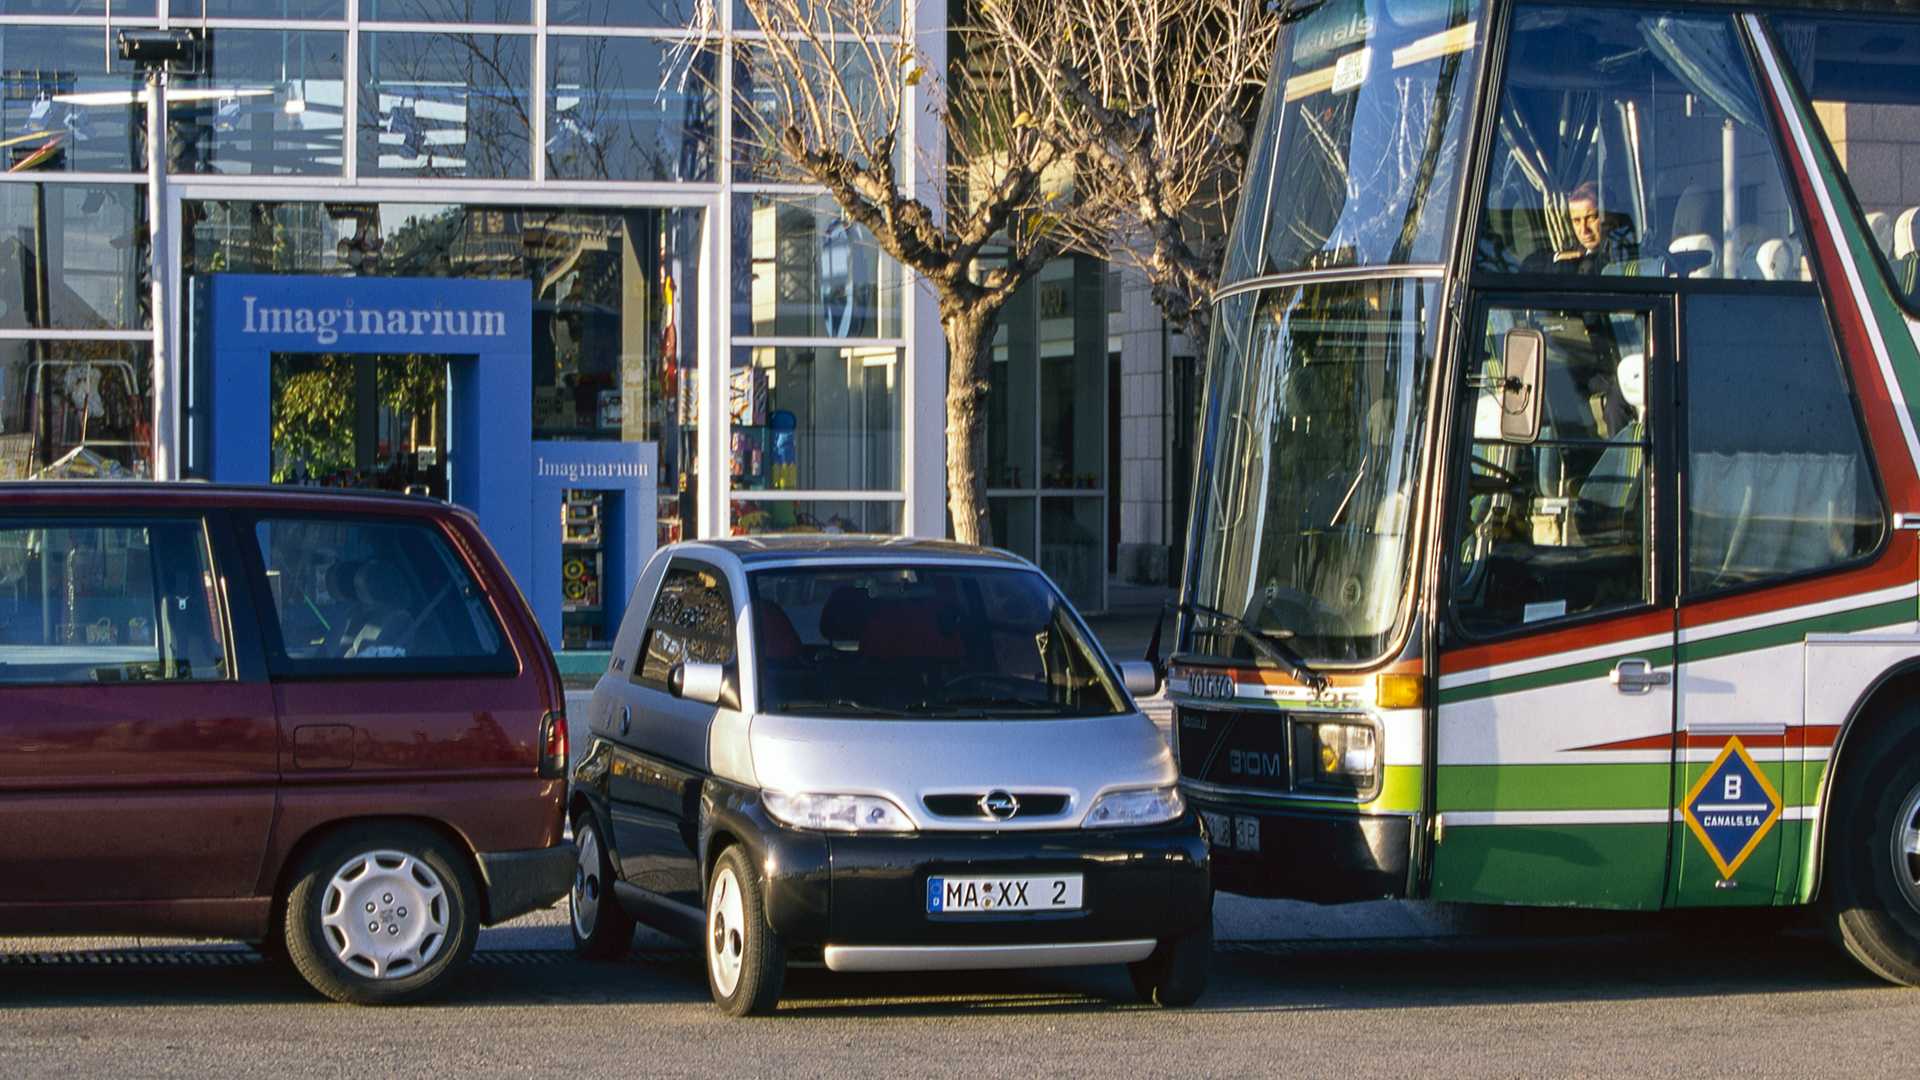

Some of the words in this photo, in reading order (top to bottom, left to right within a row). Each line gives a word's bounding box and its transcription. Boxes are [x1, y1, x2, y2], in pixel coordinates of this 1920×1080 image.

[242, 296, 506, 344] Imaginarium
[538, 457, 648, 481] Imaginarium
[1189, 672, 1234, 700] VOLVO
[1724, 774, 1741, 800] B
[946, 882, 978, 907] MA
[997, 881, 1029, 907] XX
[1052, 880, 1066, 905] 2
